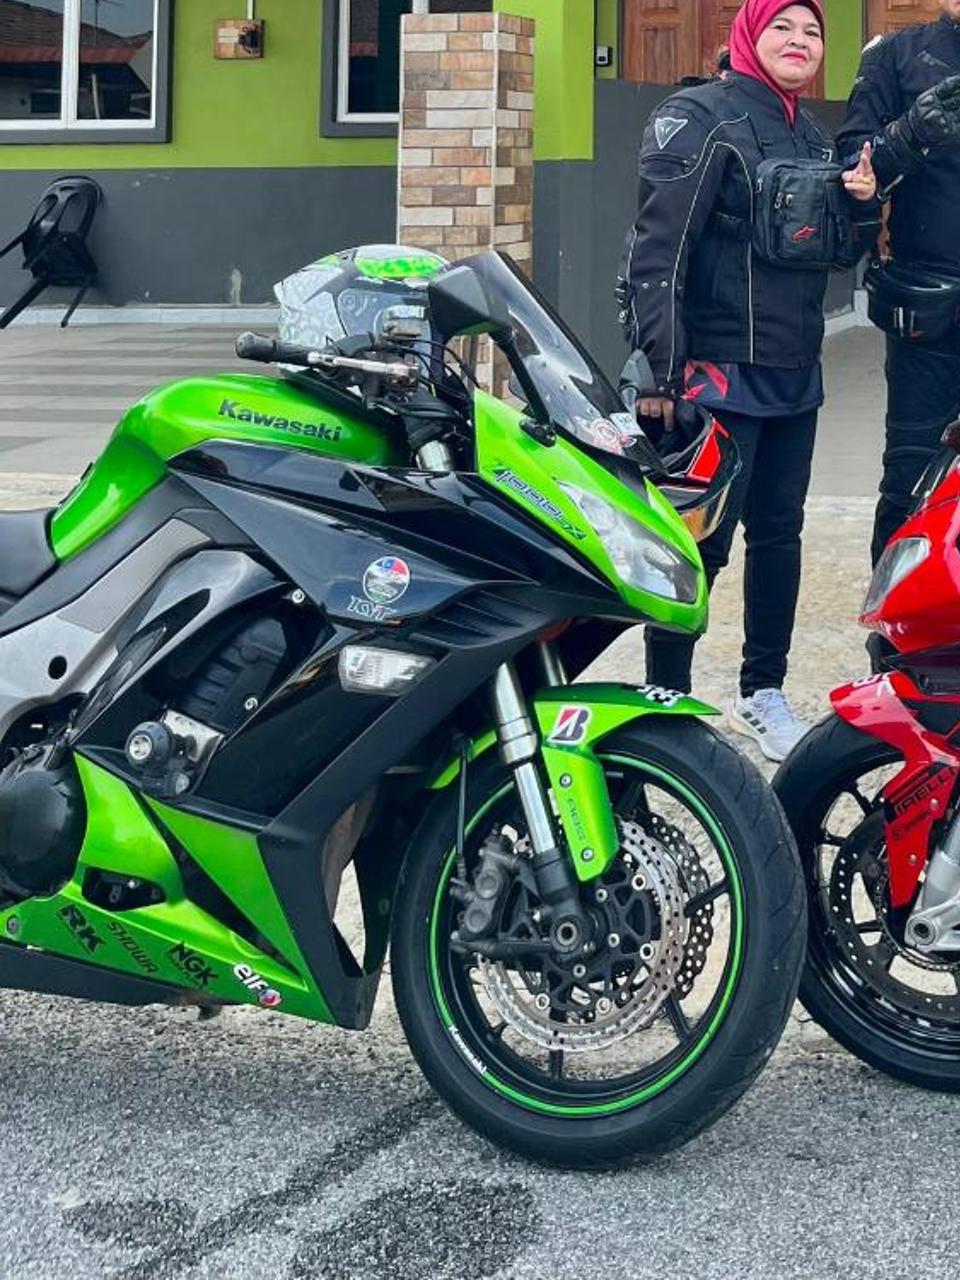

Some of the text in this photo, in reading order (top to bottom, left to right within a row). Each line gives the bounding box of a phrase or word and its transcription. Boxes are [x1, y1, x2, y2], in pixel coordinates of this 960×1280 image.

[218, 399, 342, 441] Kawasaki
[56, 903, 105, 956] RK
[108, 920, 160, 974] SHOWA
[168, 941, 219, 987] NGK
[233, 962, 269, 995] elf
